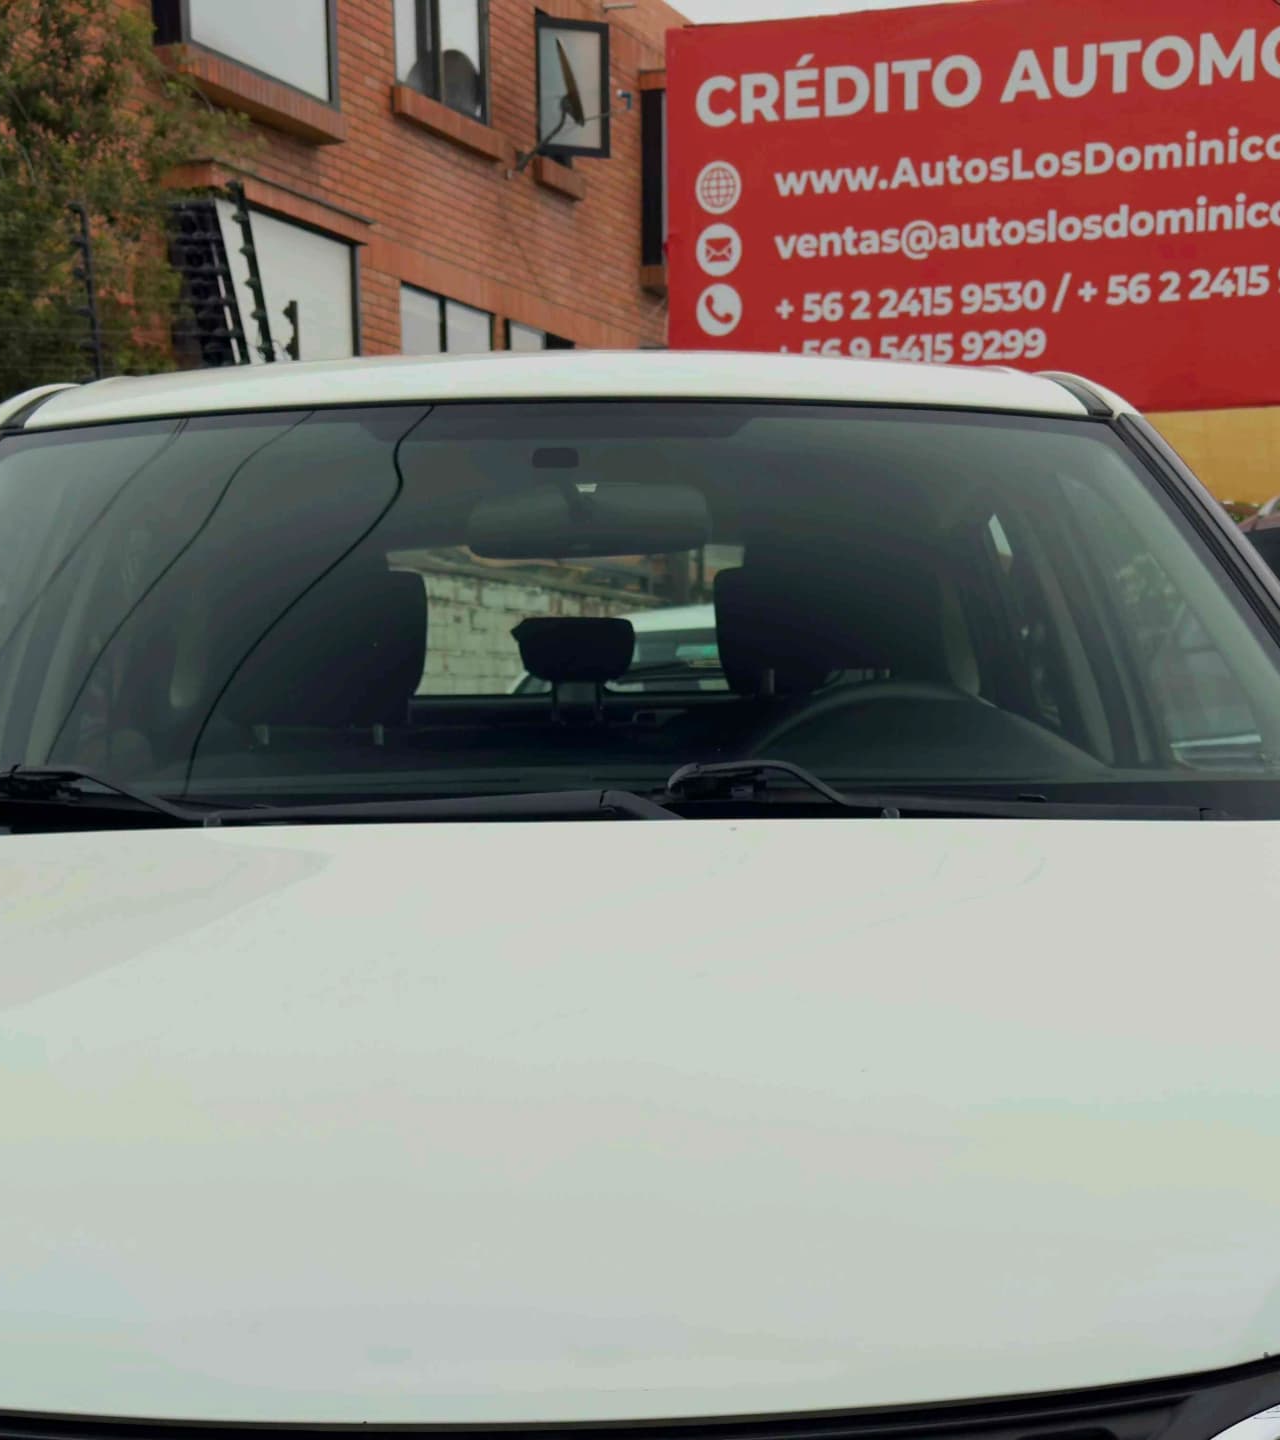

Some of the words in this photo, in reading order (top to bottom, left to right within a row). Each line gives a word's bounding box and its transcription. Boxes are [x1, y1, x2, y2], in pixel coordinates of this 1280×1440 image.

[695, 53, 983, 128] CRÉDITO
[774, 298, 795, 320] +
[801, 291, 844, 323] 56
[850, 289, 872, 321] 2
[877, 284, 954, 319] 2415
[959, 279, 1047, 315] 9530
[1051, 272, 1073, 314] /
[1077, 281, 1099, 303] +
[1105, 272, 1152, 306] 56
[1158, 270, 1181, 303] 2
[1187, 264, 1270, 301] 2415
[879, 332, 955, 363] 5415
[960, 326, 1047, 362] 9299
